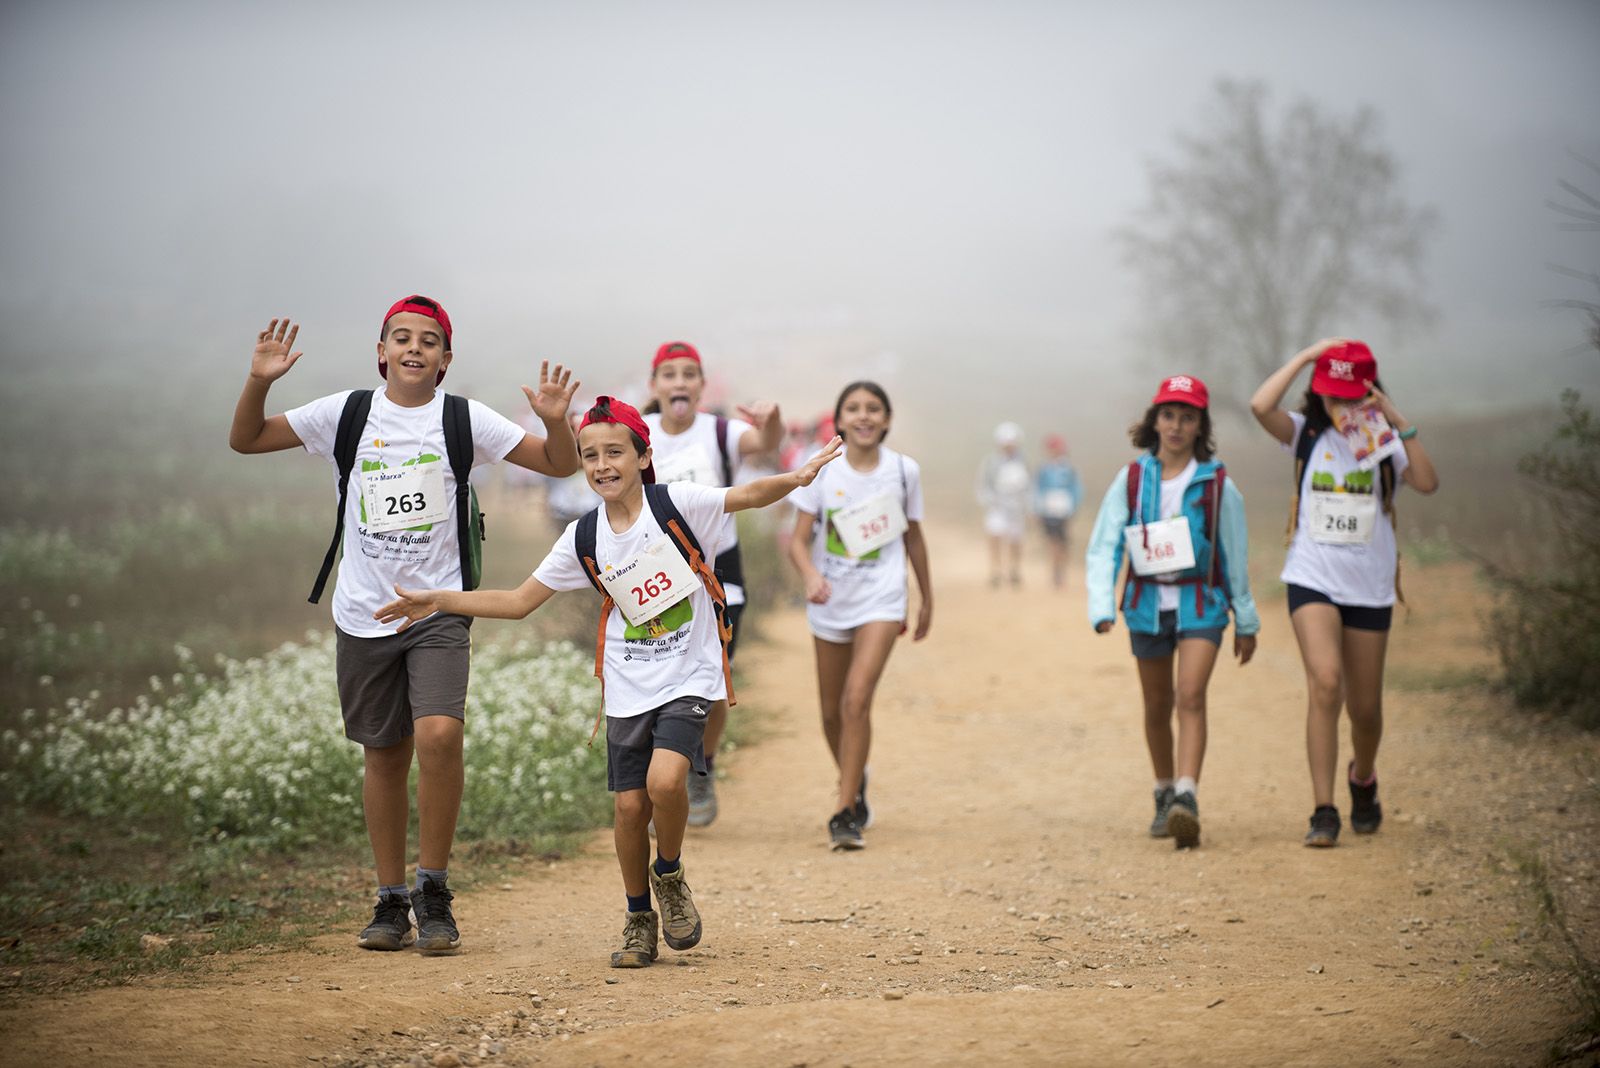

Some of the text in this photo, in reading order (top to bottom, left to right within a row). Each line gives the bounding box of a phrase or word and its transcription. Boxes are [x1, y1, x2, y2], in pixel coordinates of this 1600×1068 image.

[384, 491, 427, 516] 263
[858, 513, 889, 541] 267
[1325, 514, 1358, 533] 268
[399, 534, 431, 546] Infantil
[1143, 541, 1176, 562] 268
[630, 571, 673, 607] 263
